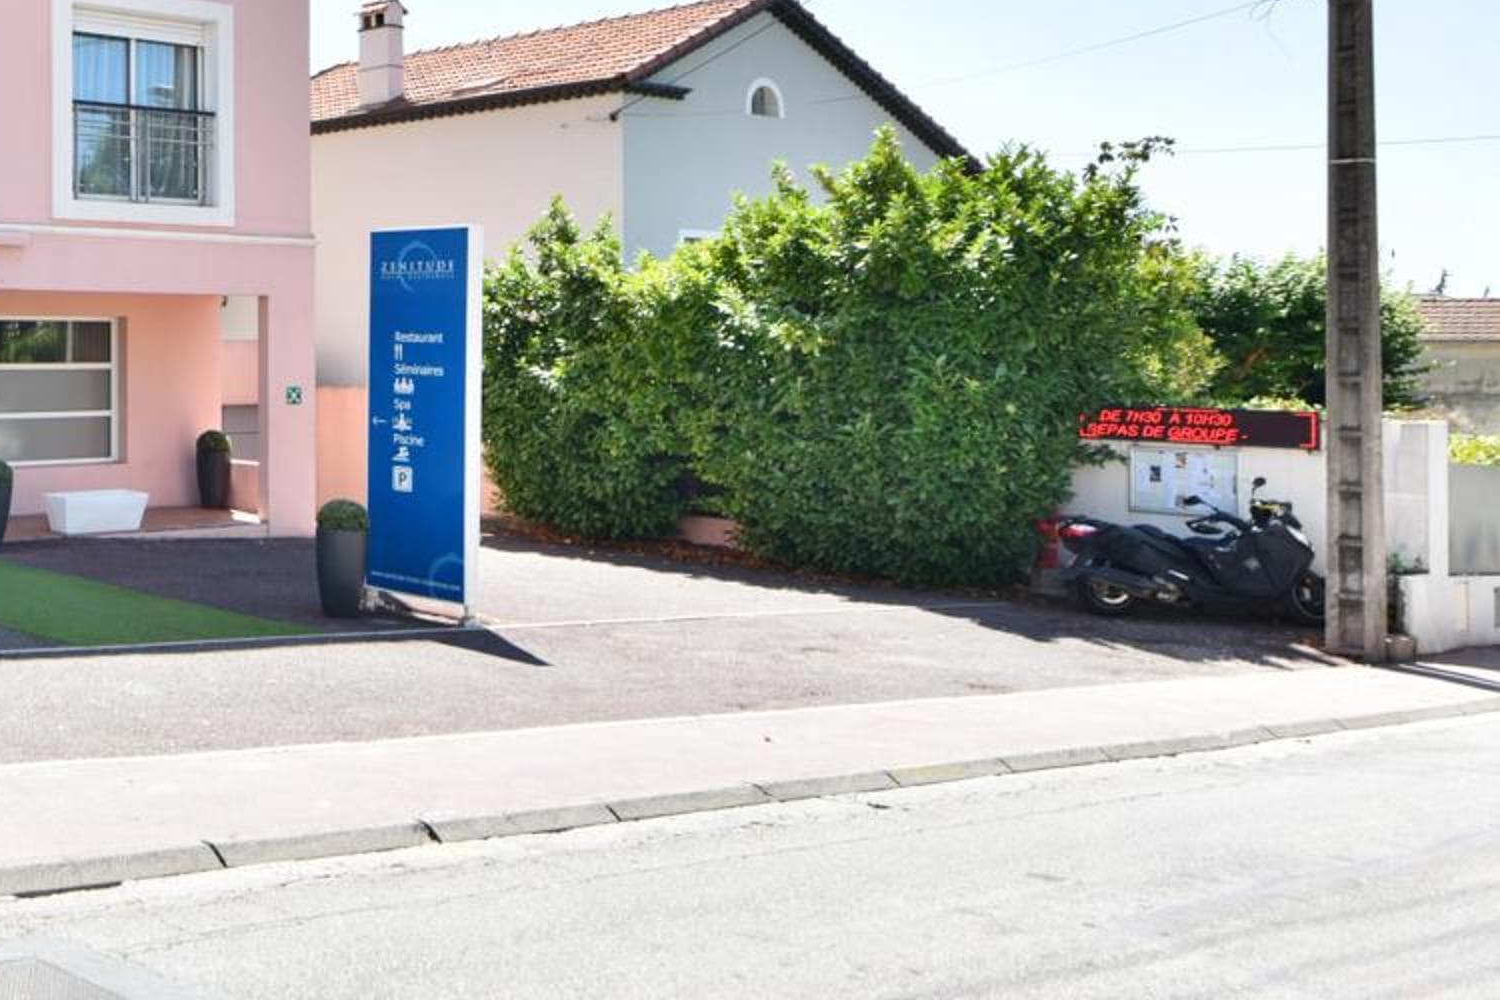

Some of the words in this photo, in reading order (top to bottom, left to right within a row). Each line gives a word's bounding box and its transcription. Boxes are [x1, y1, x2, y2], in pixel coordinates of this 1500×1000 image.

[394, 331, 443, 344] Restaurant
[394, 363, 445, 377] Séminaires
[393, 398, 411, 411] Spa
[1100, 410, 1121, 422] DE
[1187, 414, 1232, 426] 10H30
[393, 433, 425, 447] Piscine
[1142, 426, 1164, 438] DE
[1168, 427, 1239, 442] GROUPE
